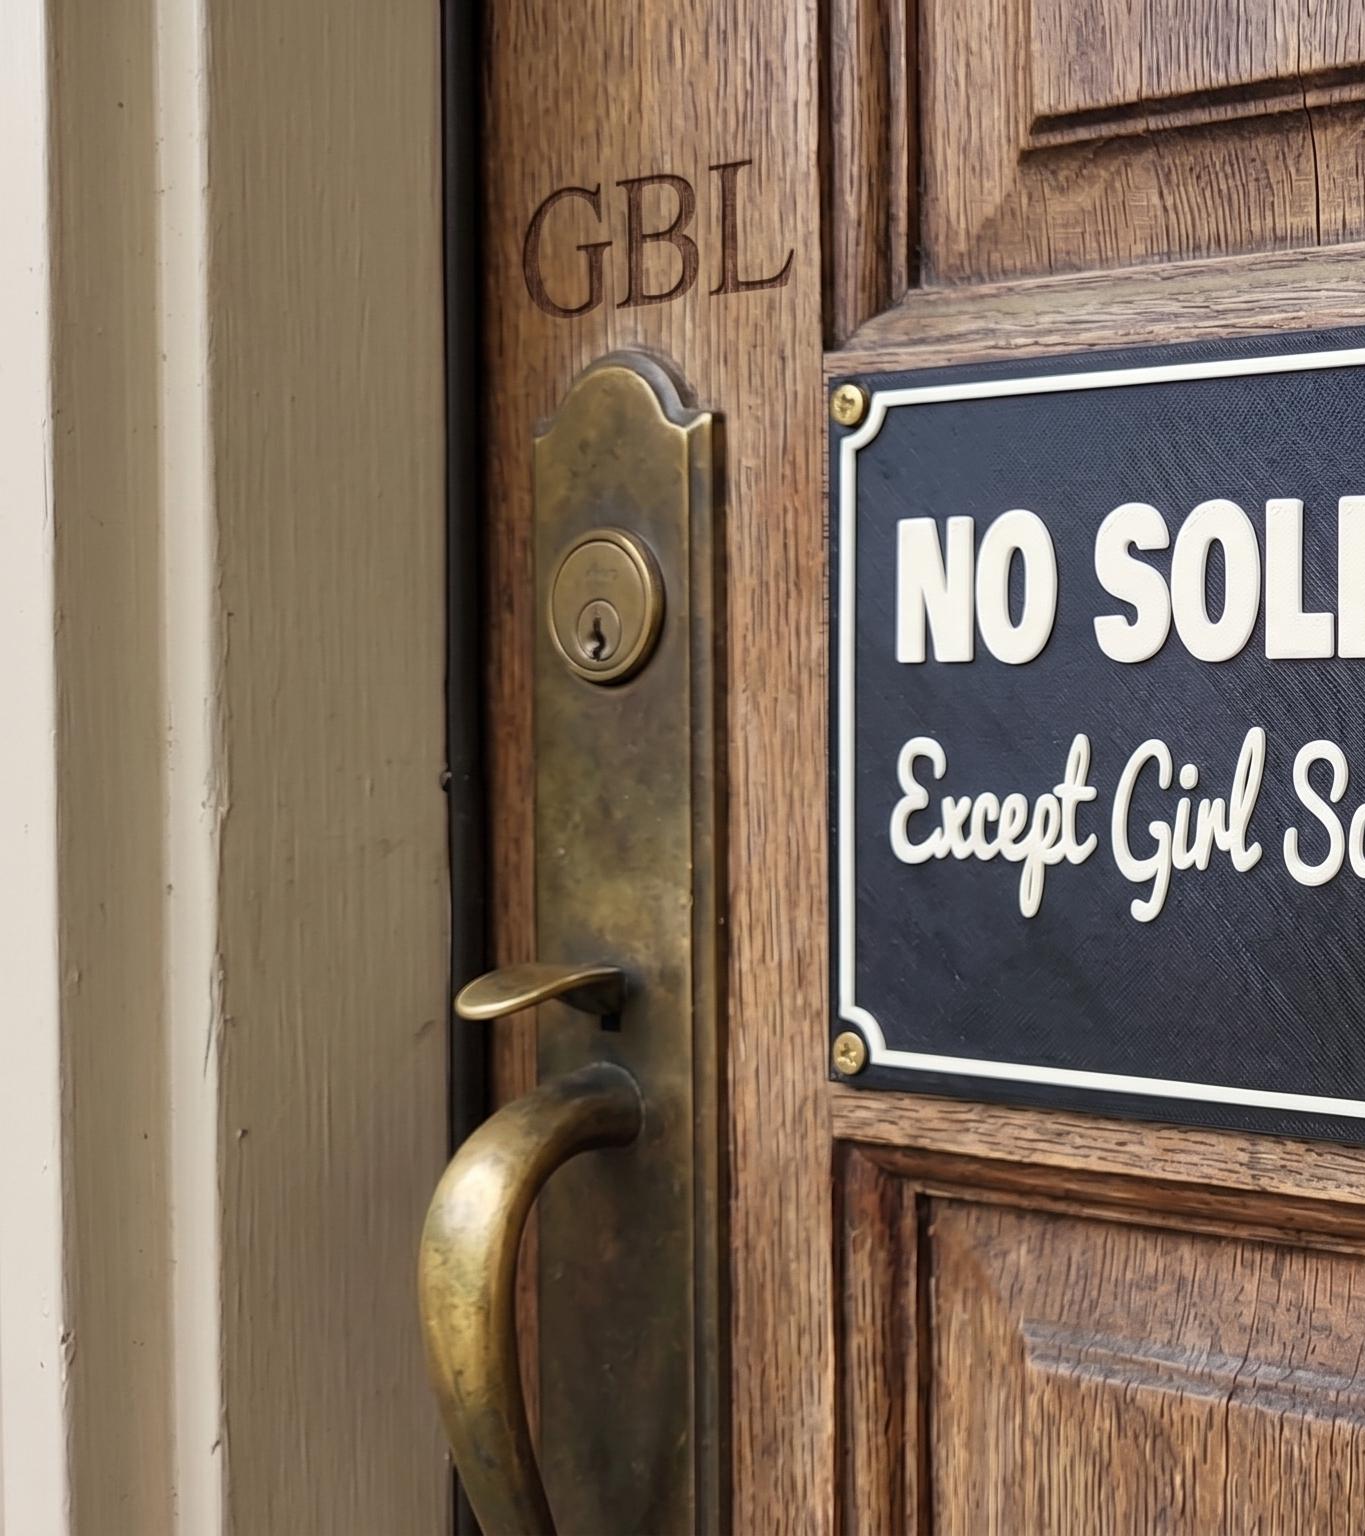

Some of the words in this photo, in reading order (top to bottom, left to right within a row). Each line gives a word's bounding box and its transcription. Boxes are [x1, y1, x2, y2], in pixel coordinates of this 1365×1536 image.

[522, 158, 795, 319] GBL
[895, 507, 1059, 666] NO
[889, 732, 1099, 919] Except
[1111, 725, 1267, 924] Girl
